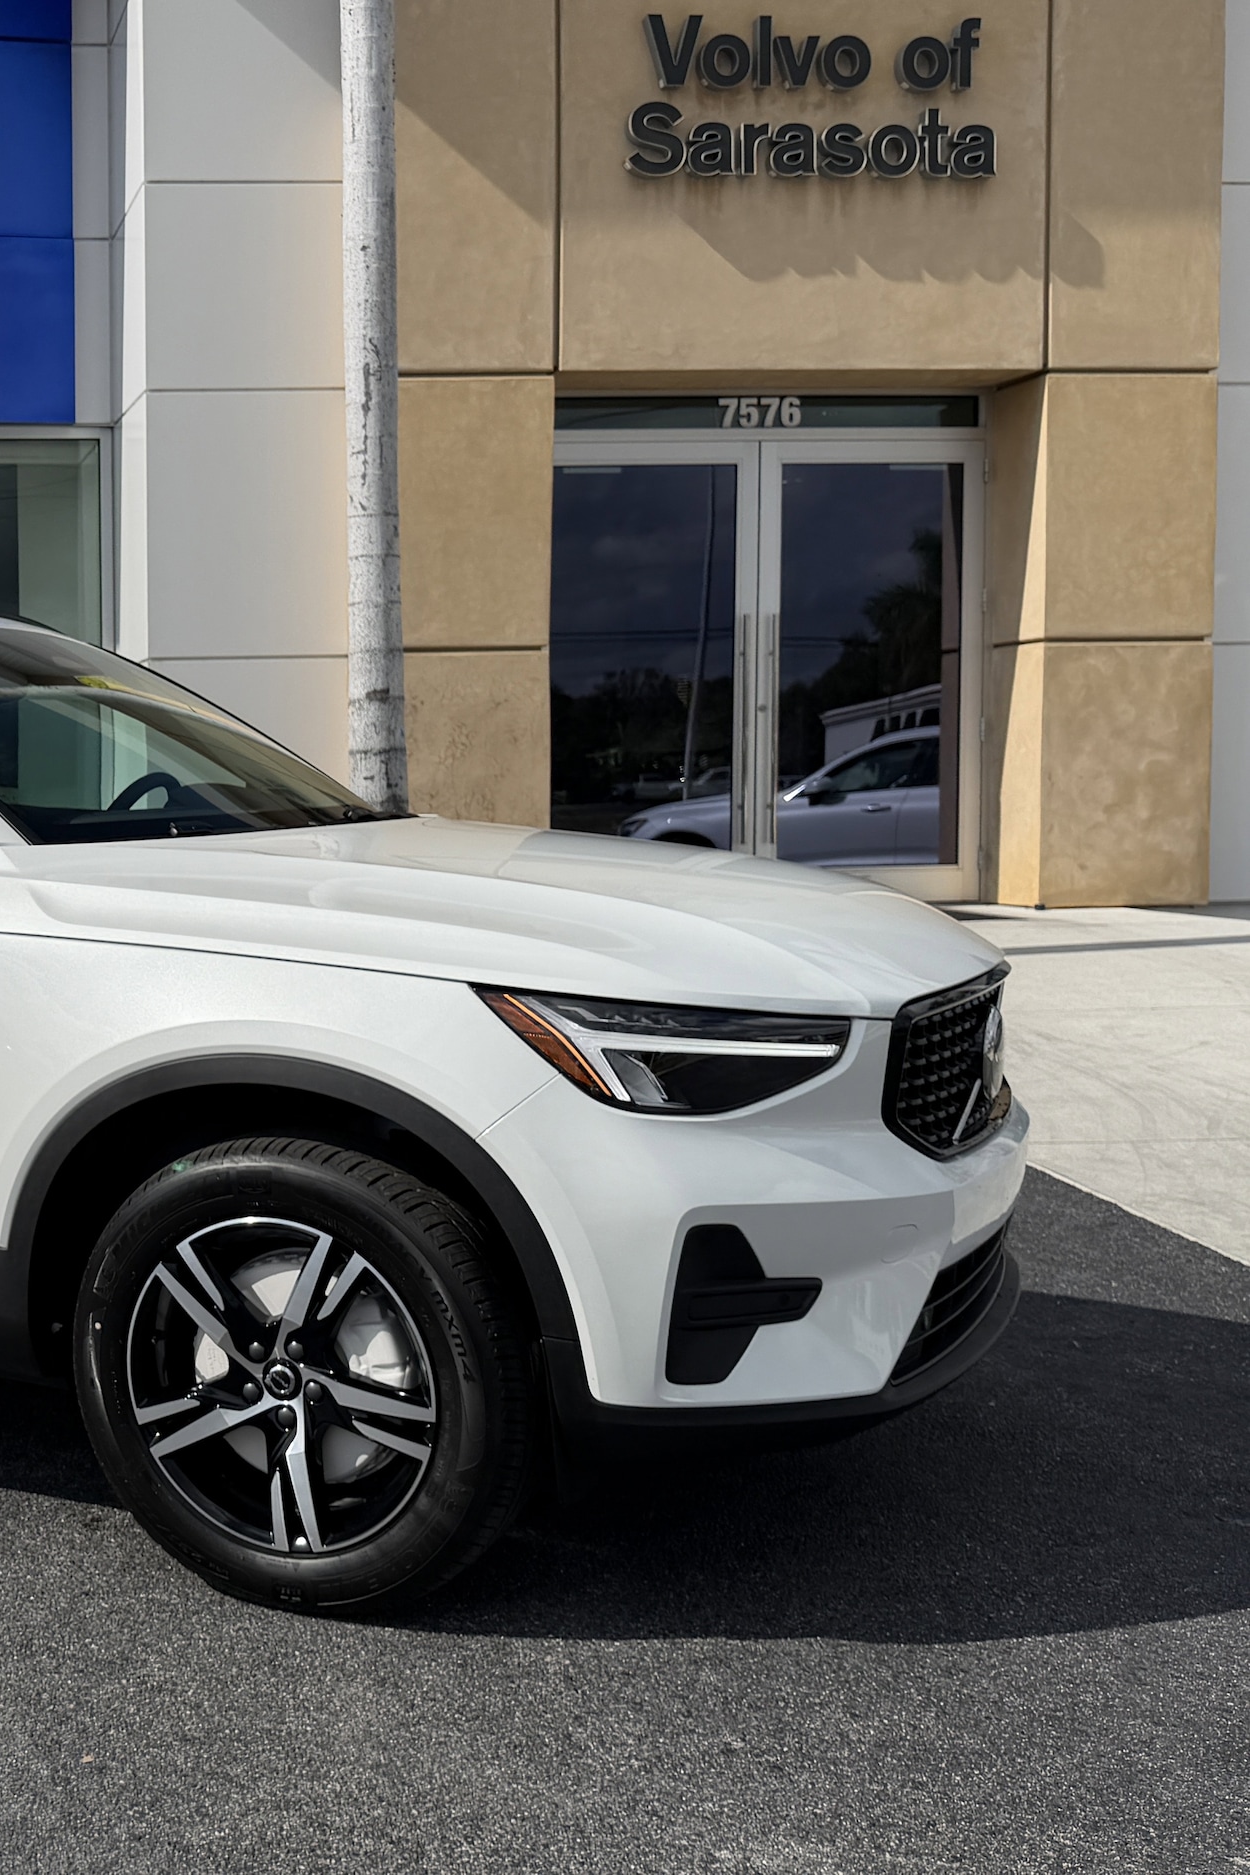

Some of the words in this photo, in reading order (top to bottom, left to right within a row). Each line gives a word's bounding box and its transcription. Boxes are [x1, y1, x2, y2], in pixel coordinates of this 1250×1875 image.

[643, 13, 872, 92] Volvo
[895, 17, 982, 93] of
[624, 101, 998, 179] Sarasota
[718, 396, 802, 428] 7576
